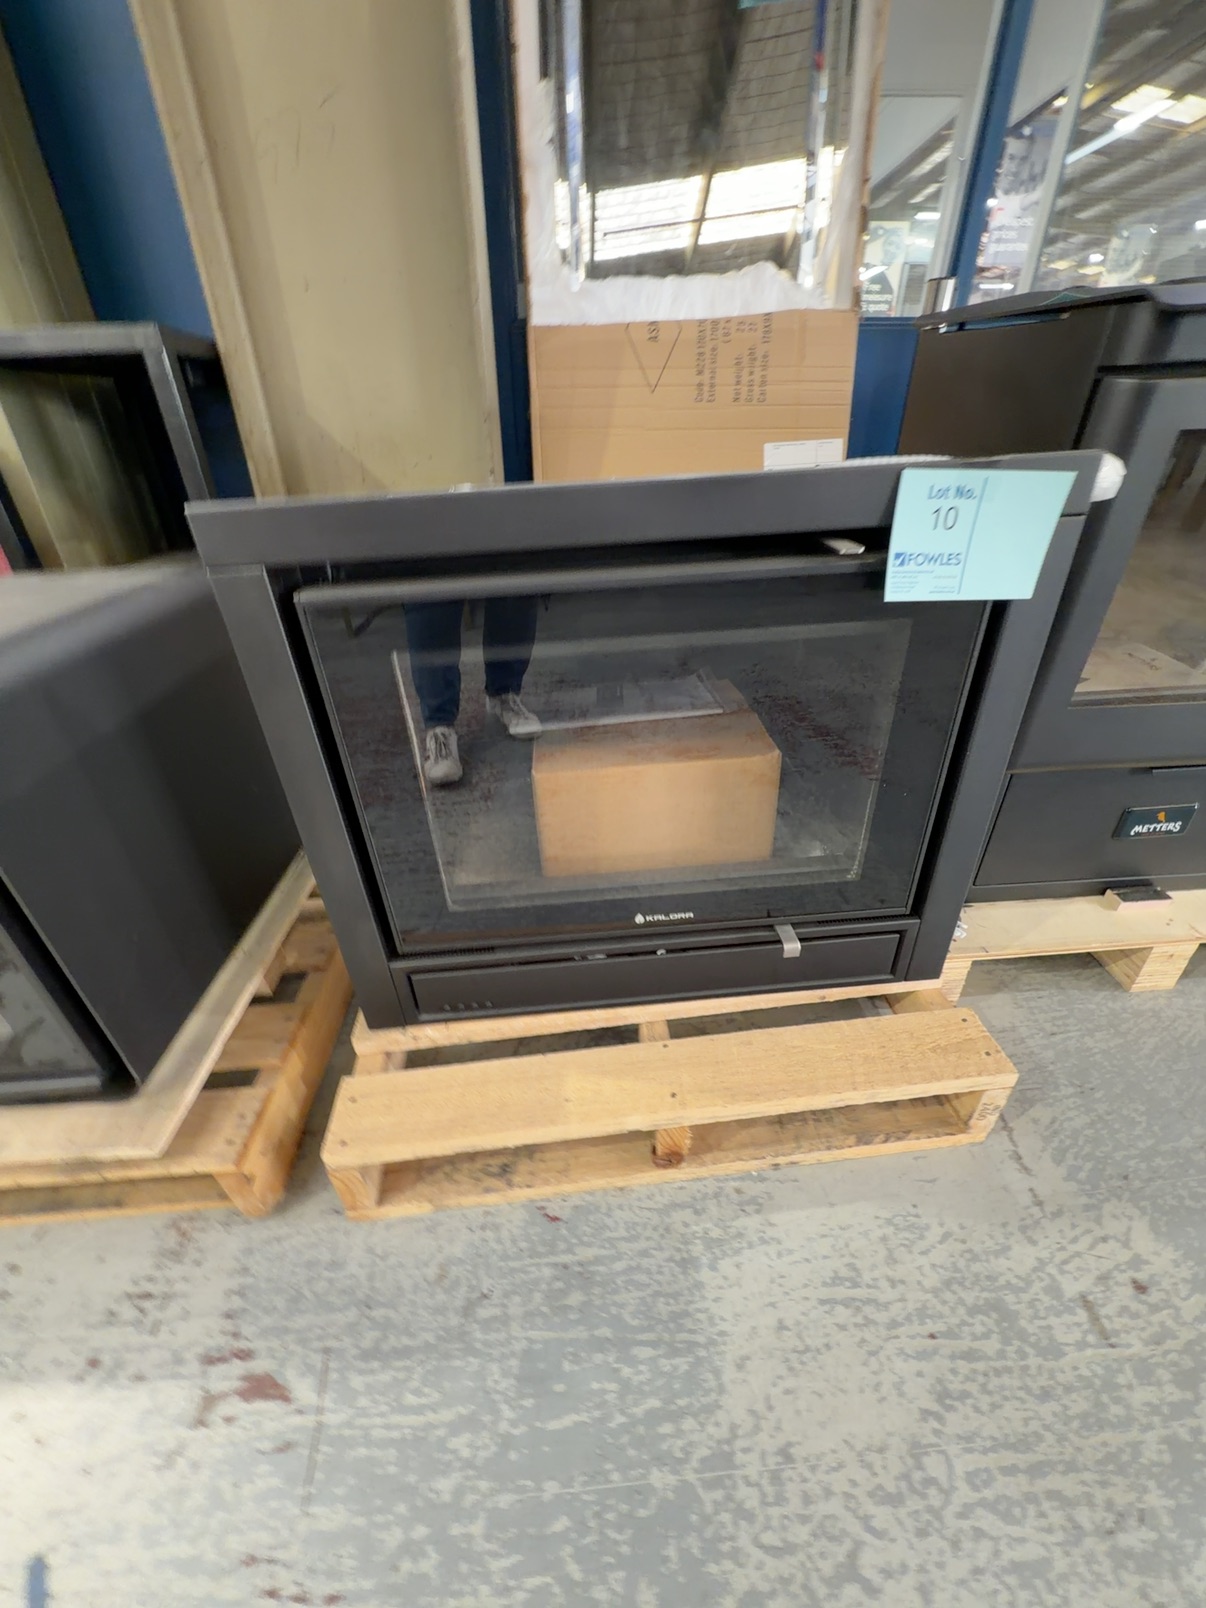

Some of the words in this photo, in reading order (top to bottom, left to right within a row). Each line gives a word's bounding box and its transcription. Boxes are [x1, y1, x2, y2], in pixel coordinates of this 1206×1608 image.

[927, 484, 951, 500] Lot
[953, 484, 978, 500] No.
[931, 505, 959, 531] 10
[907, 552, 963, 567] FOWLES
[1130, 820, 1182, 836] METTERS
